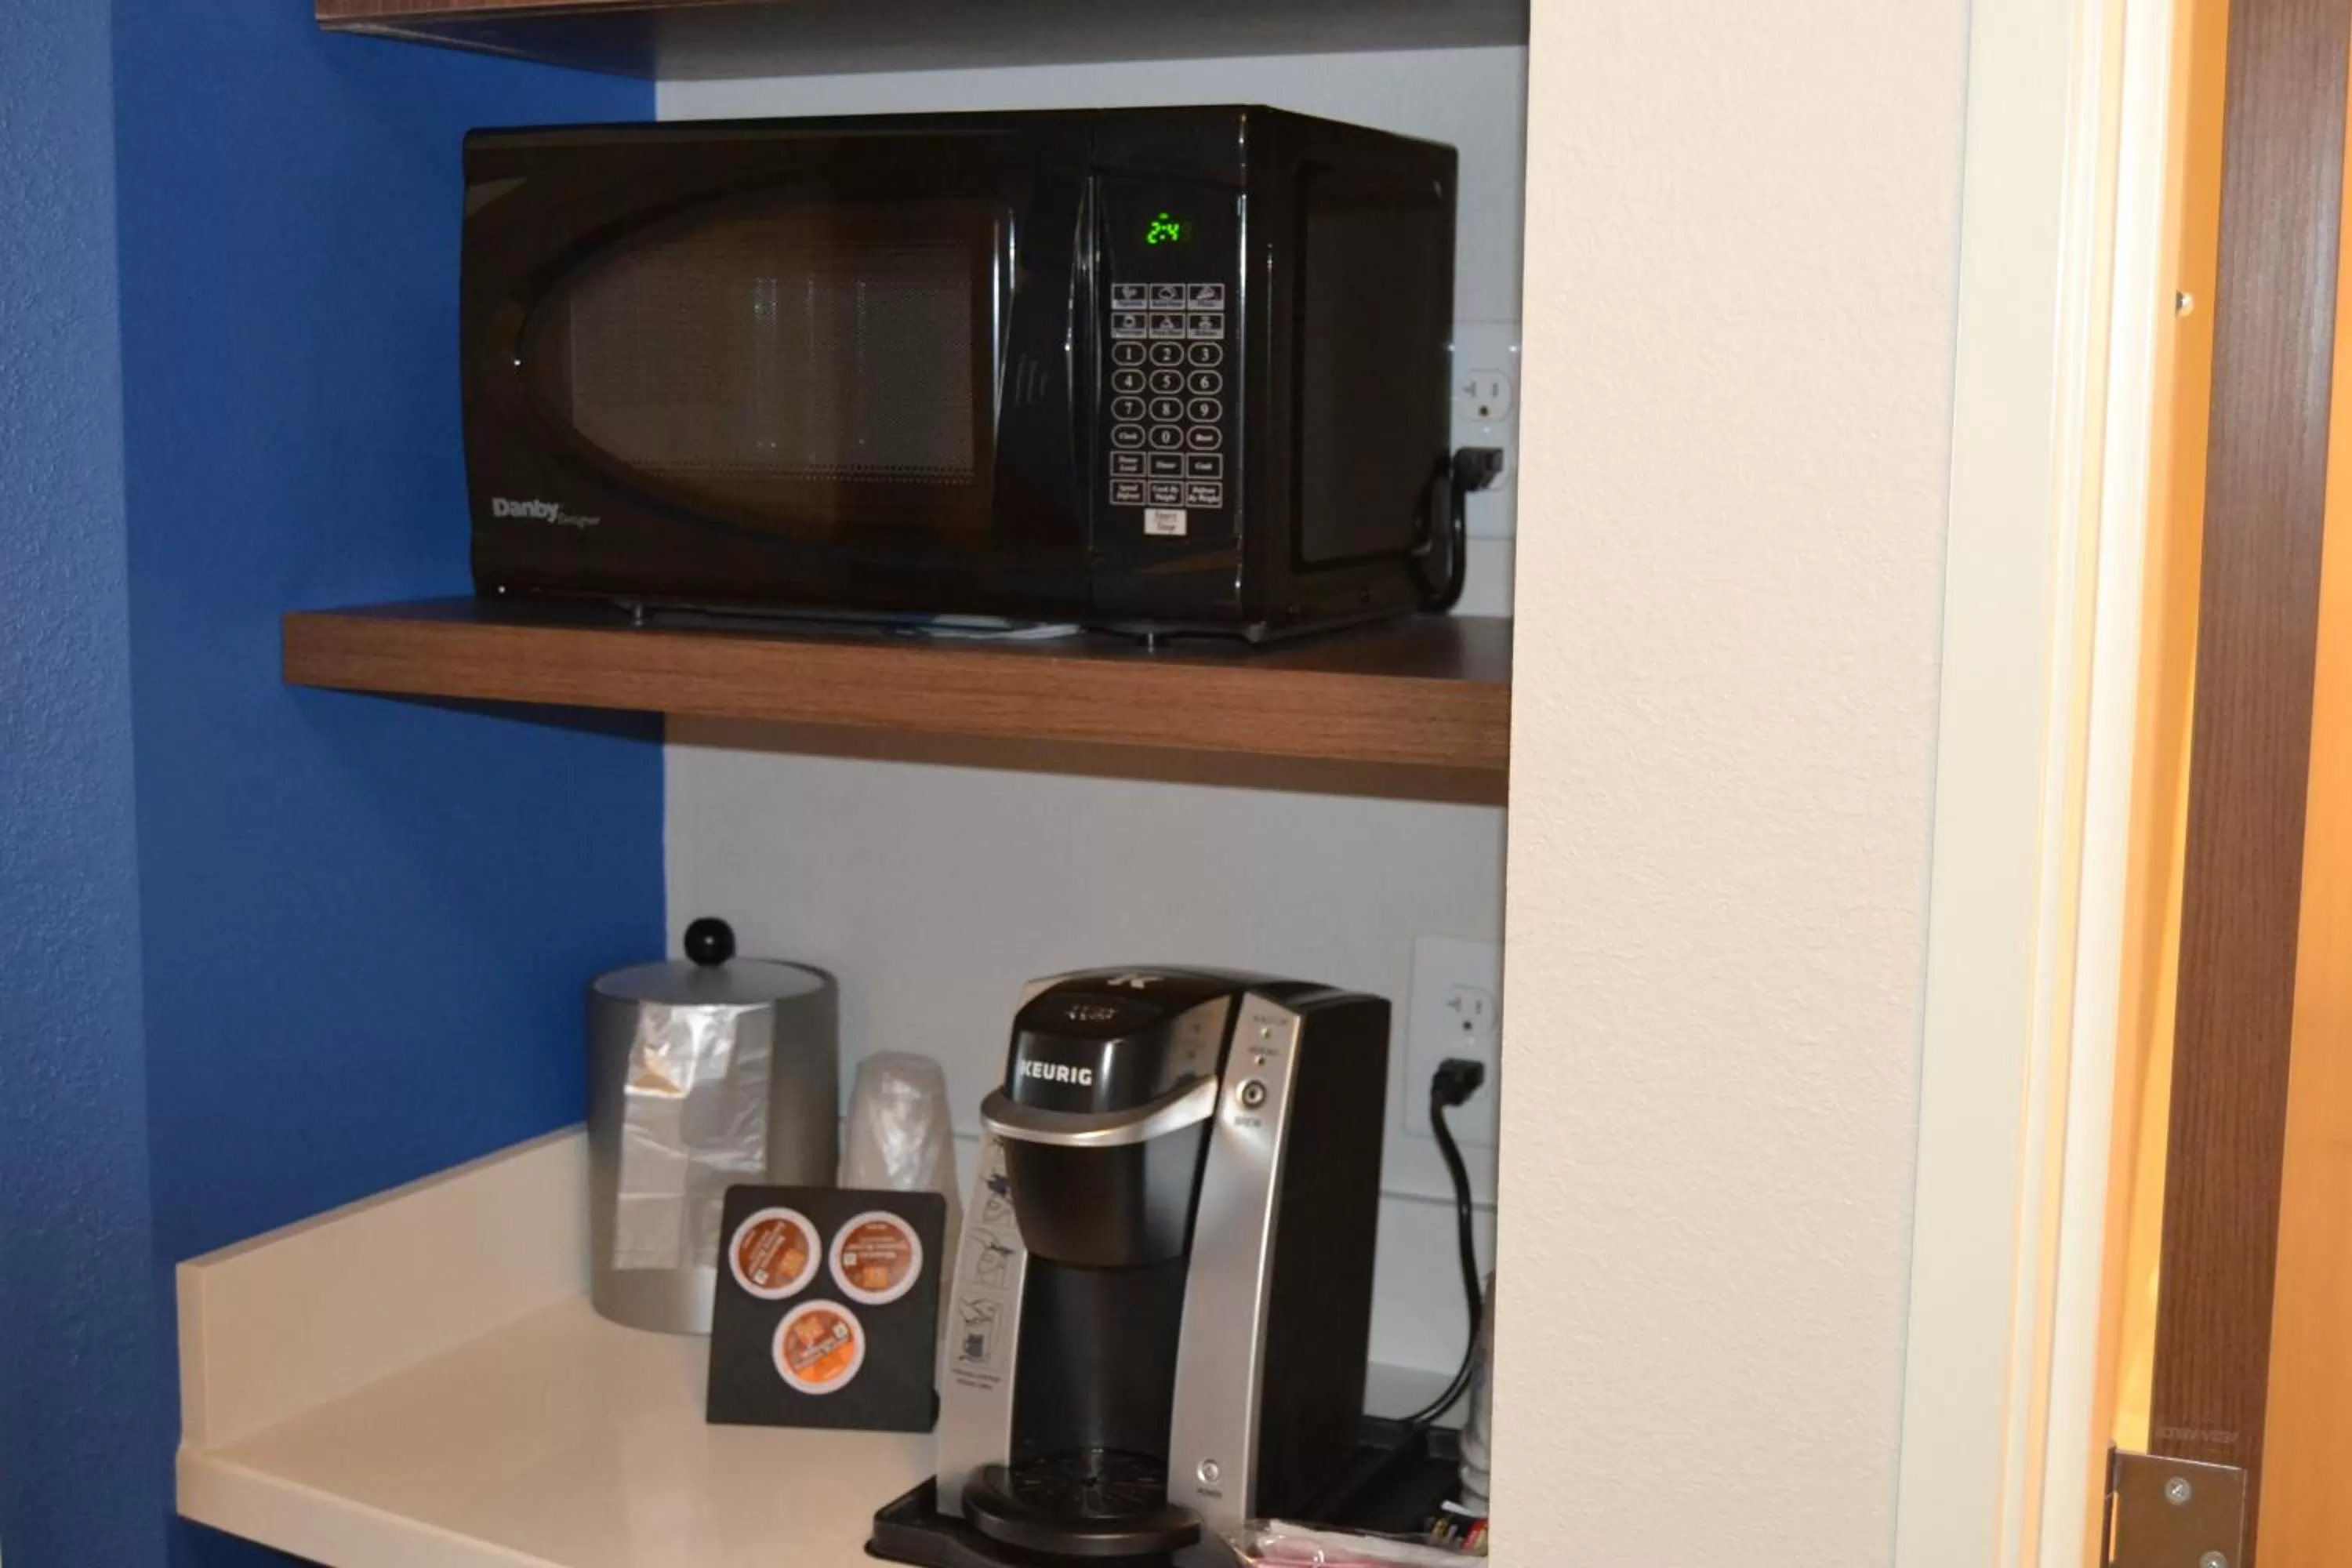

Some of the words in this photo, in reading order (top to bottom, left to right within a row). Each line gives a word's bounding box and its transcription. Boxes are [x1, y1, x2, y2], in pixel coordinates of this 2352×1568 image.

[1126, 347, 1133, 360] 1
[1163, 347, 1172, 361] 2
[1201, 347, 1210, 361] 3
[1124, 375, 1133, 387] 4
[1163, 375, 1171, 388] 5
[1200, 376, 1210, 389] 6
[1124, 401, 1133, 414] 7
[1162, 402, 1171, 416] 8
[1200, 403, 1209, 416] 9
[1161, 430, 1171, 444] 0
[492, 497, 559, 523] Danby
[1022, 1060, 1092, 1087] KEURIG
